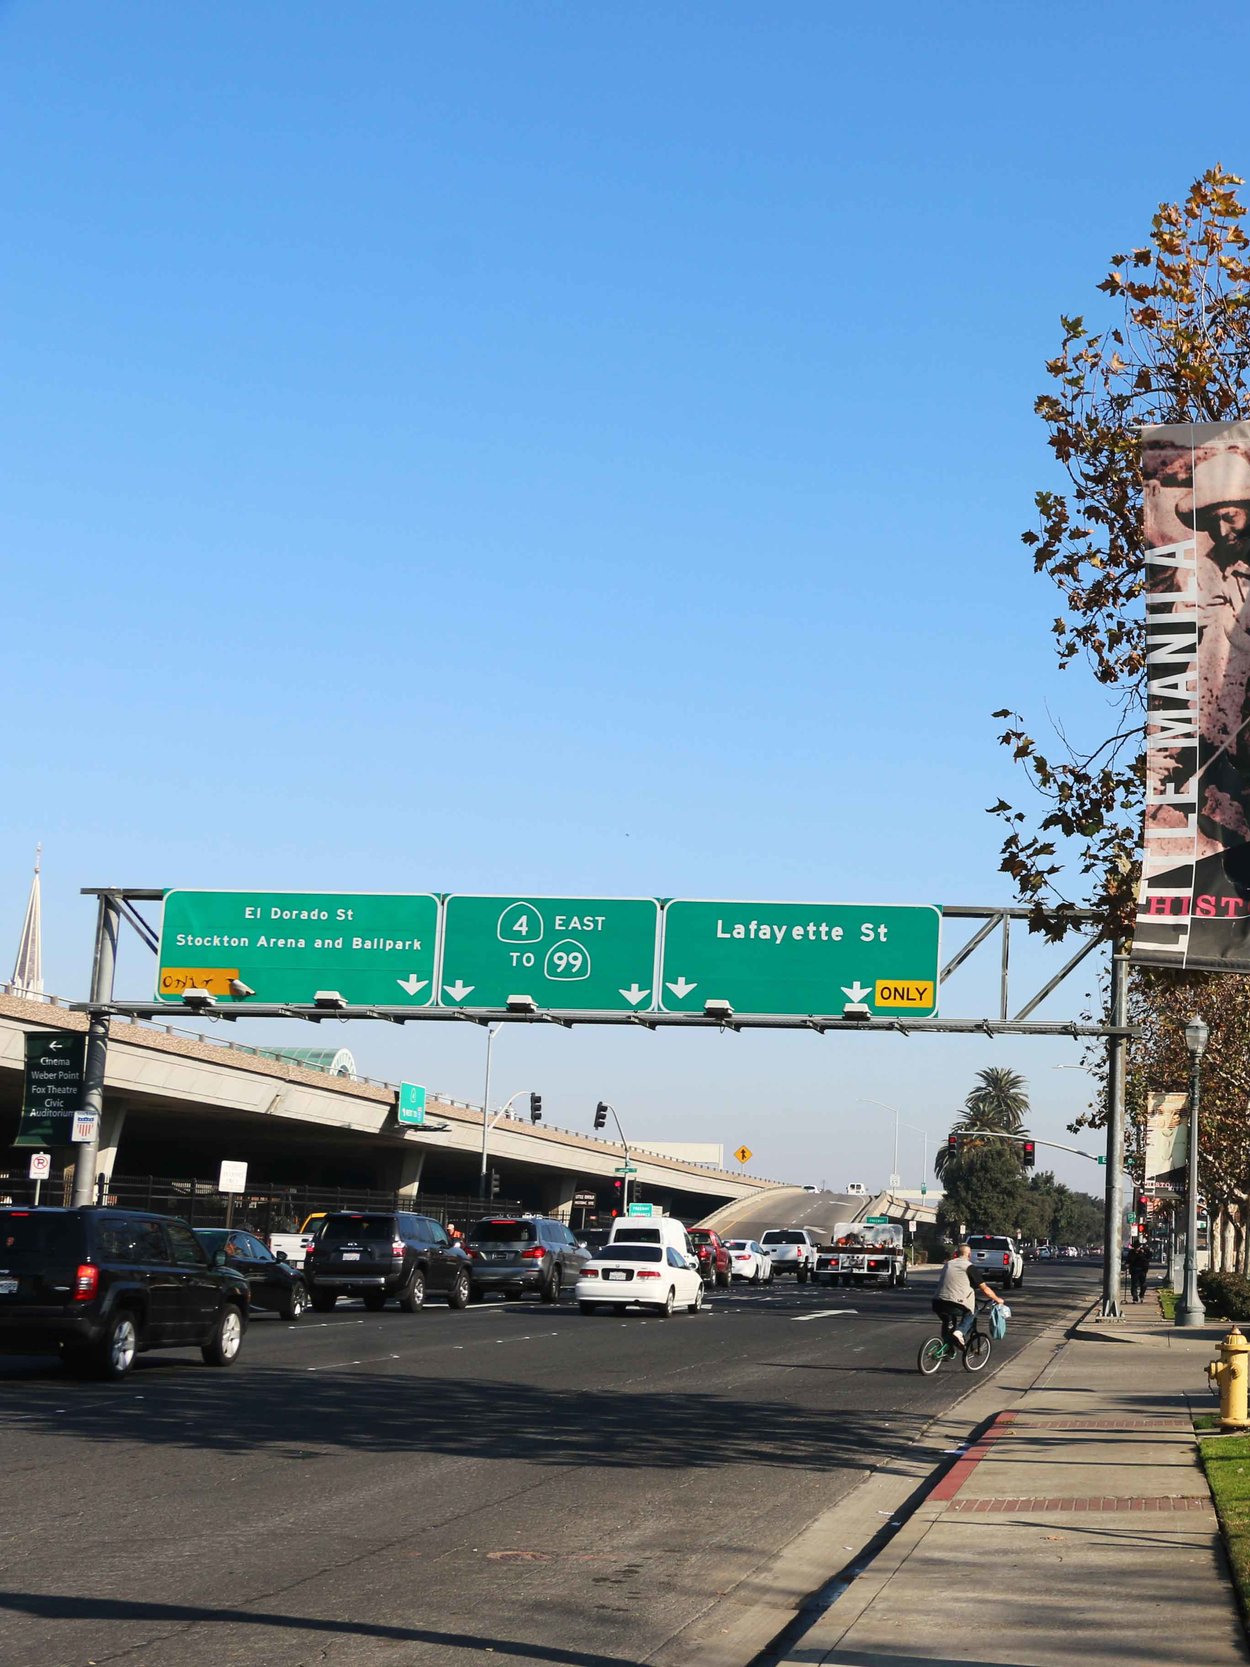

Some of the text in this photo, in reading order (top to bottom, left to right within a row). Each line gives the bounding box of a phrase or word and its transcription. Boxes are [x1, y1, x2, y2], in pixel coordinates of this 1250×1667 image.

[1132, 537, 1198, 953] LITTLE MANILA
[245, 907, 353, 921] El Dorado St
[512, 915, 529, 936] 4
[555, 915, 606, 931] EAST
[716, 919, 888, 944] Lafayette St
[176, 933, 421, 951] Stockton Arena and Ballpark
[509, 952, 535, 967] TO
[552, 951, 583, 973] 99
[880, 986, 928, 1001] ONLY
[40, 1057, 70, 1066] Cinema
[31, 1071, 79, 1080] Weber Point
[31, 1085, 77, 1094] Fox Theatre
[44, 1099, 64, 1108] Civic
